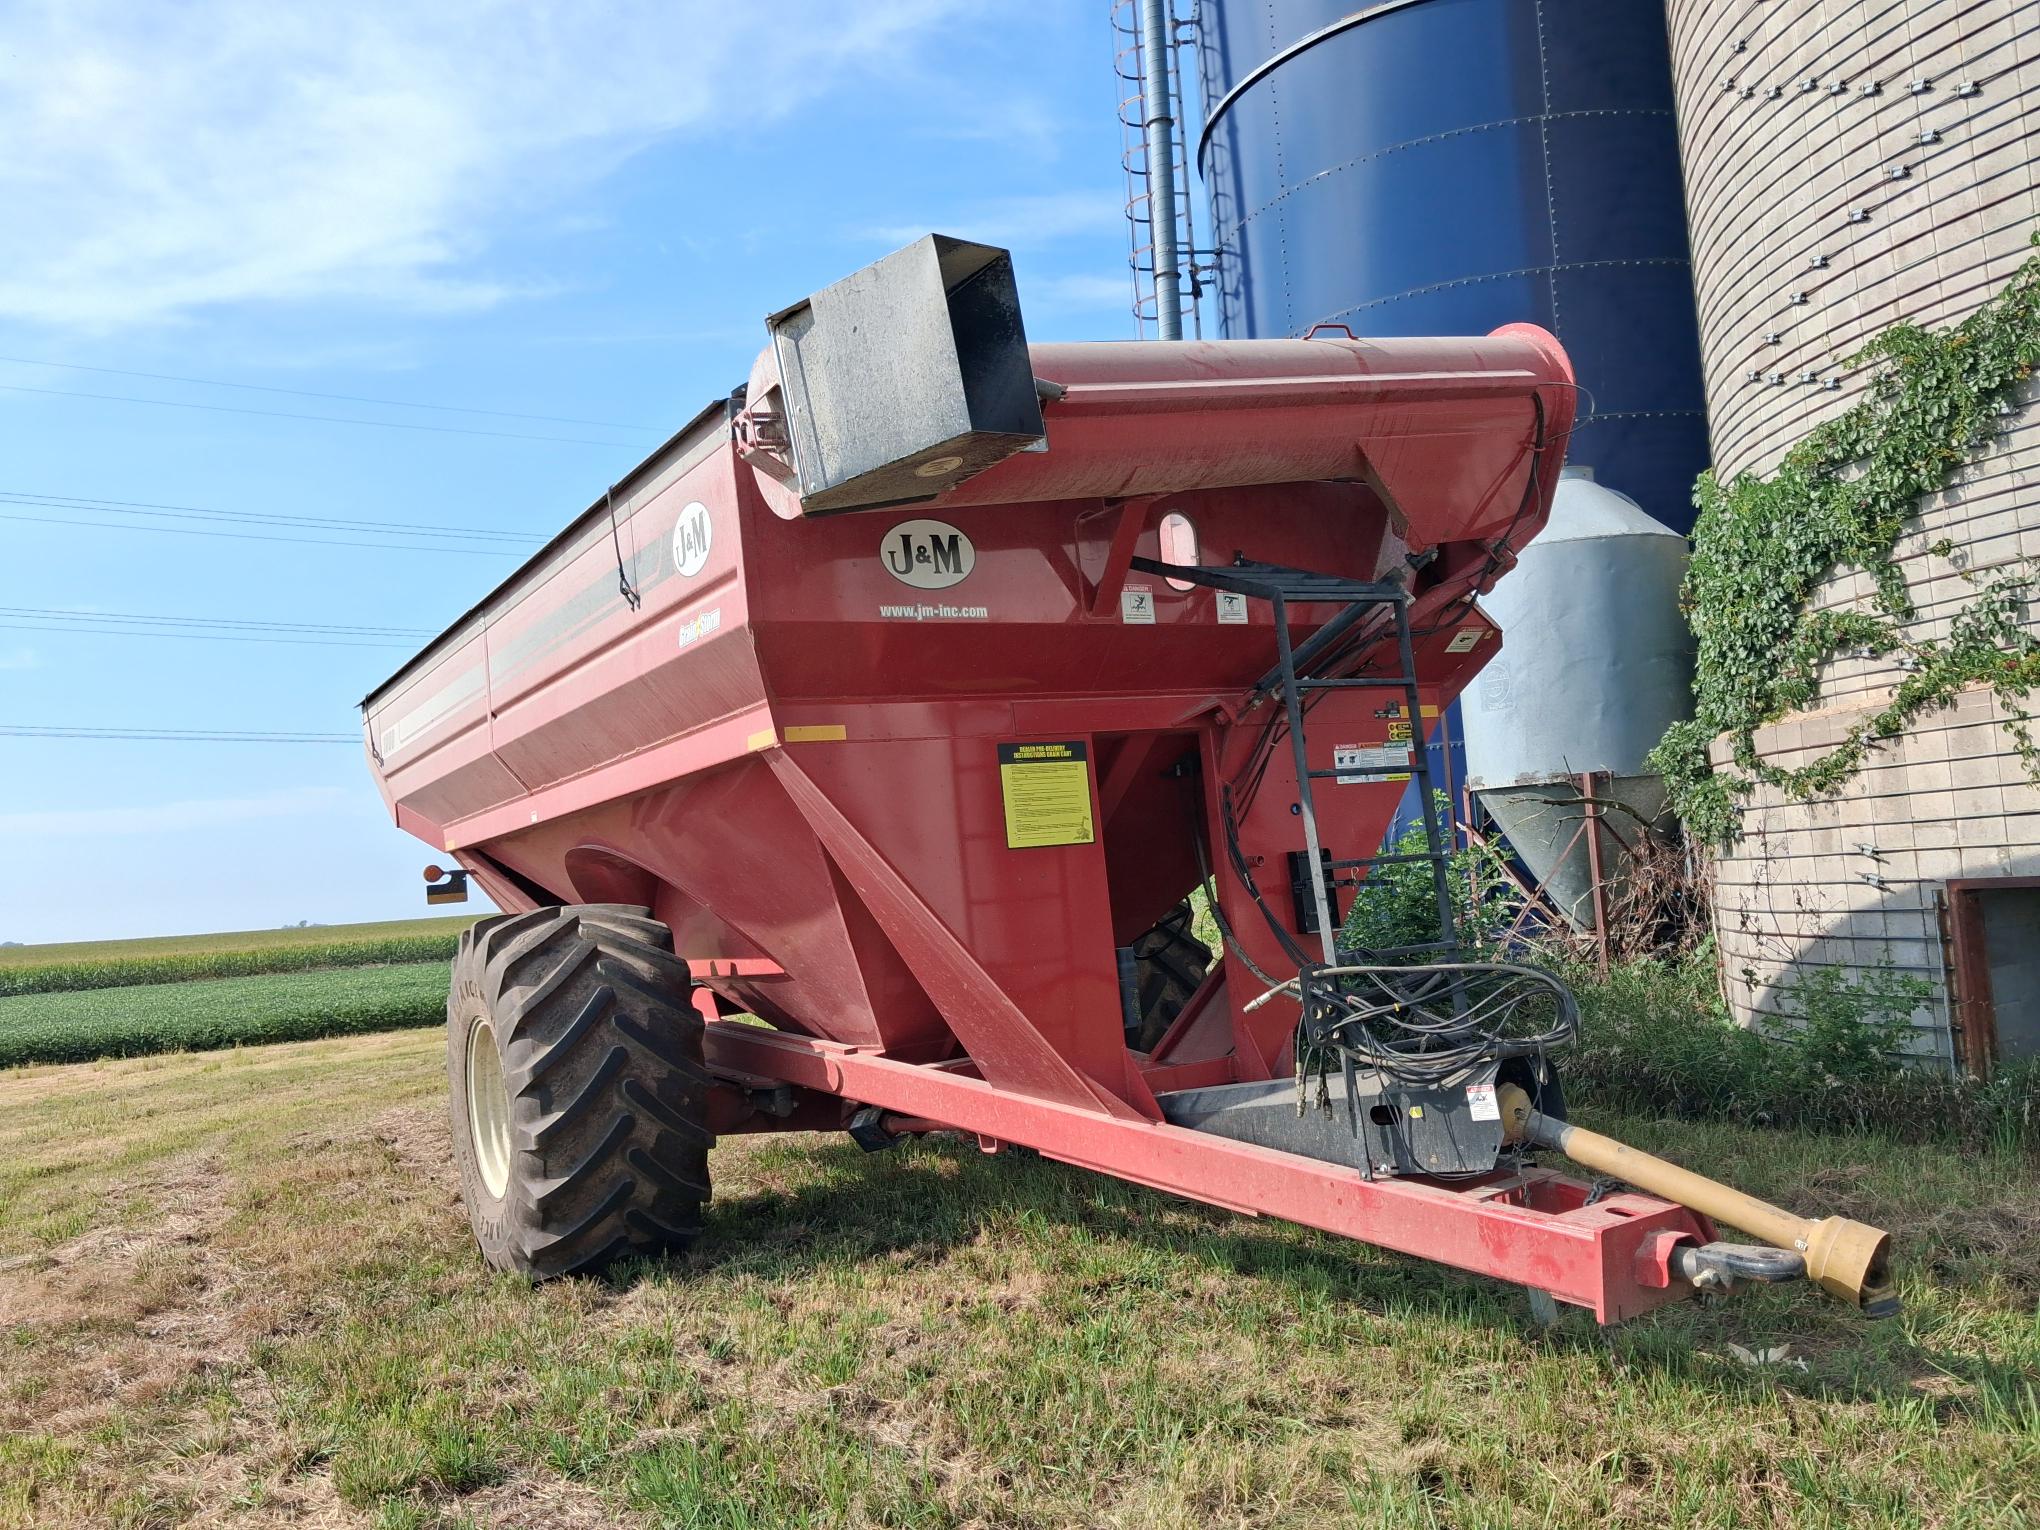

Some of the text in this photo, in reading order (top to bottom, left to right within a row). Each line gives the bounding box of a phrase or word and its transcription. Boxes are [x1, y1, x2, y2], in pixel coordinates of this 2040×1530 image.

[676, 510, 707, 567] J&M
[888, 534, 963, 575] J&M
[880, 603, 988, 621] www.jm-inc.com
